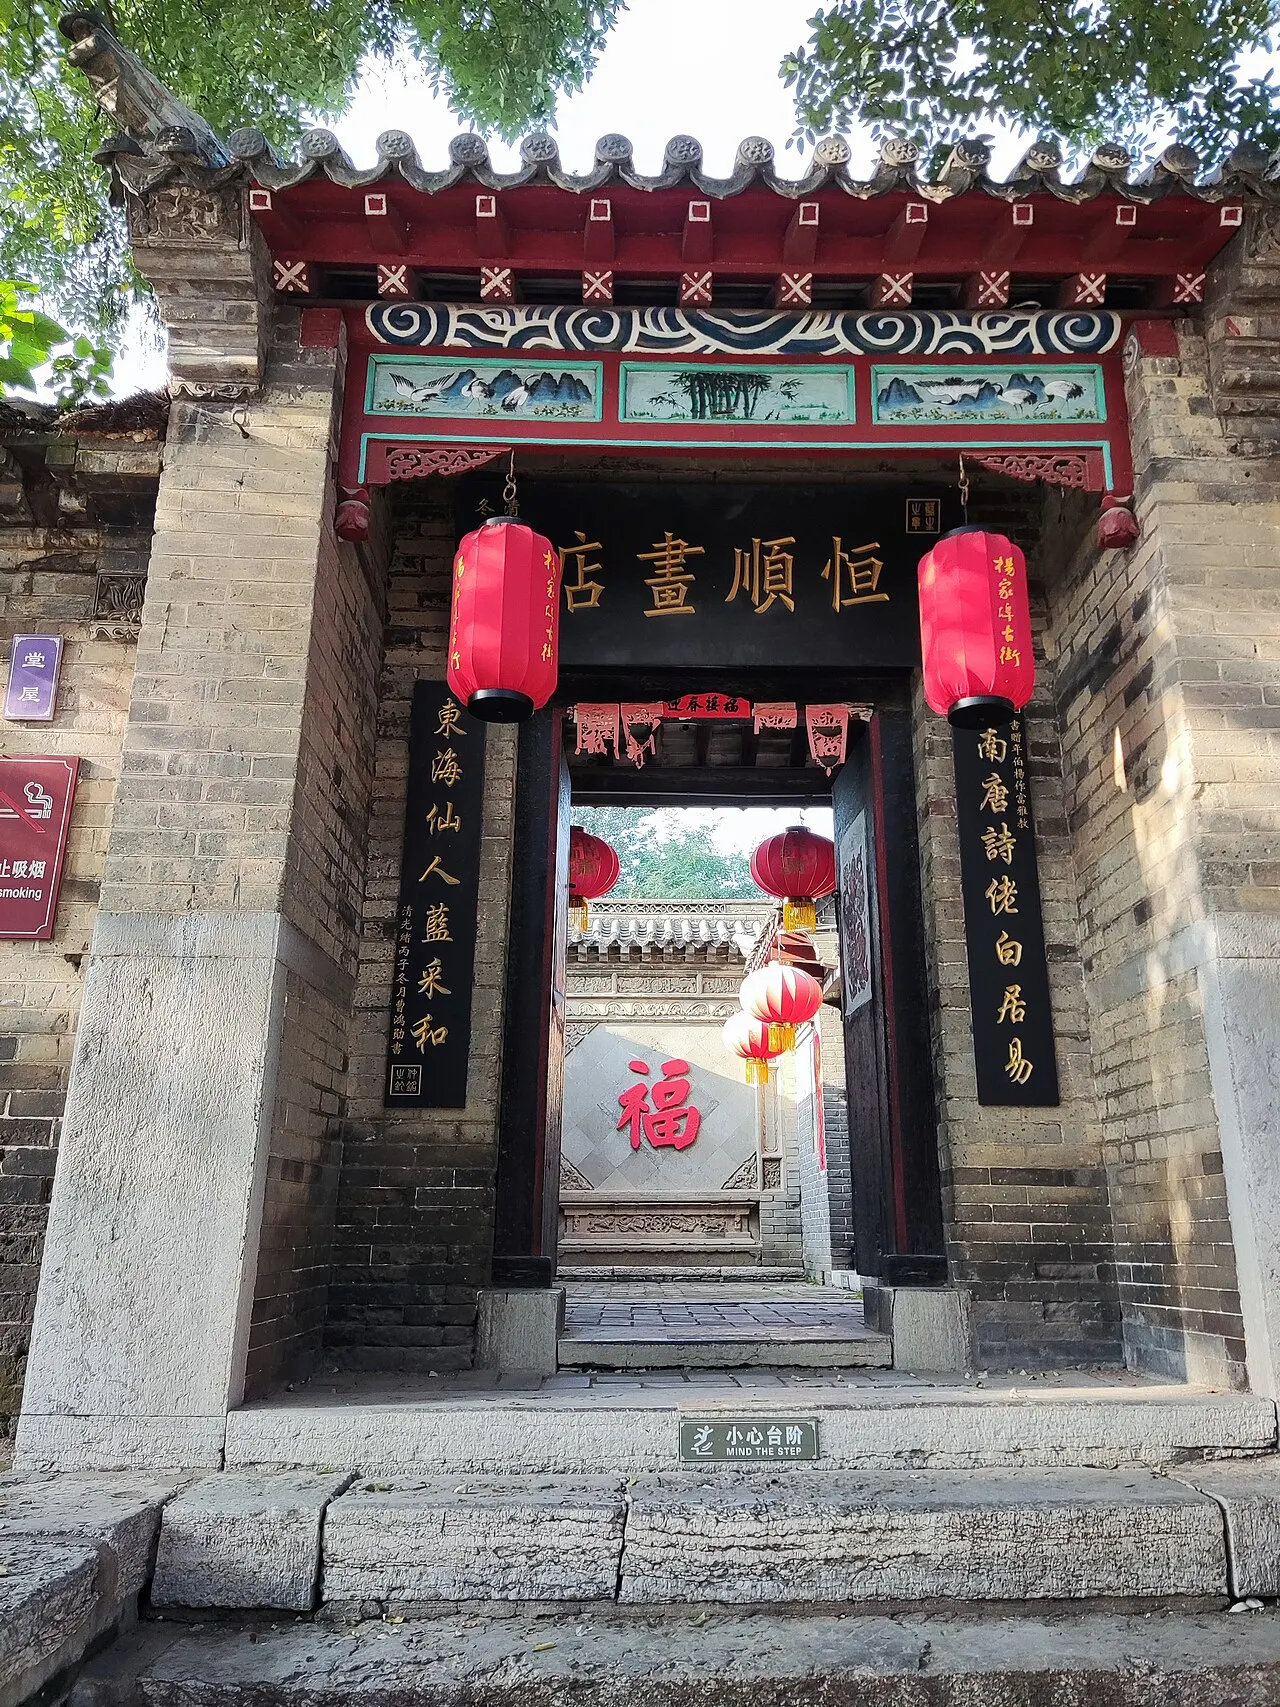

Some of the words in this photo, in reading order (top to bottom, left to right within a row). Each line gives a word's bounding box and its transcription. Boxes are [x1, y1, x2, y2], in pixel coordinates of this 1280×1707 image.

[17, 651, 46, 703] 堂屋
[0, 858, 46, 879] 止吸烟
[410, 697, 468, 1055] 東海仙人藍采和
[617, 1058, 701, 1151] 福
[726, 1425, 804, 1446] 小心台阶
[726, 1447, 752, 1457] MIND
[756, 1447, 775, 1456] THE
[777, 1447, 802, 1456] STEP
